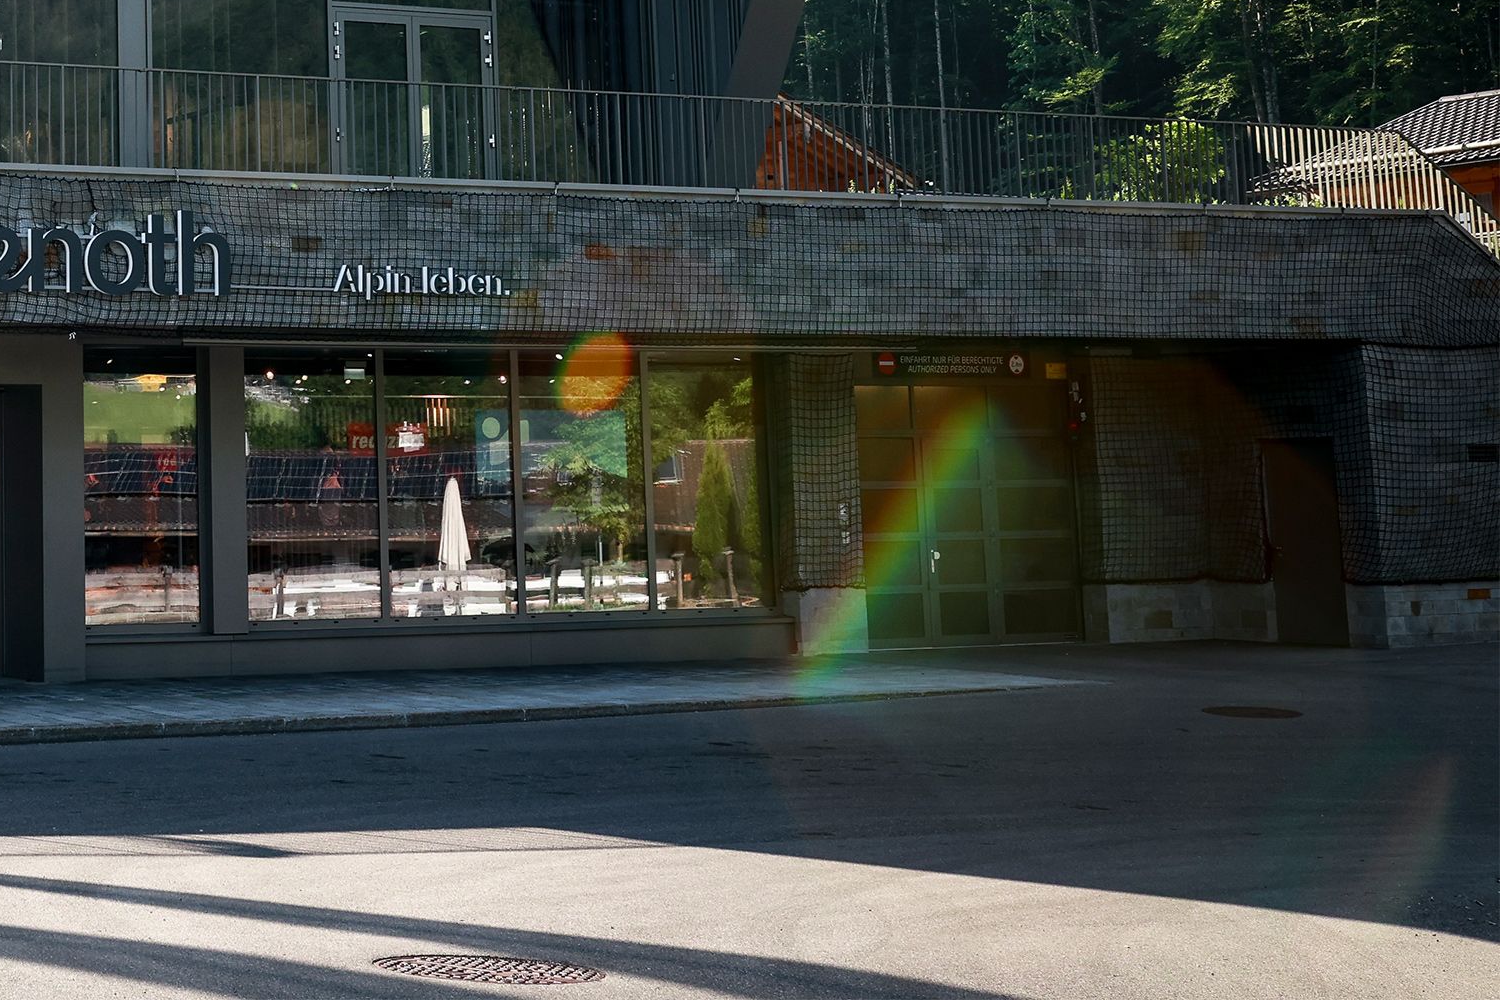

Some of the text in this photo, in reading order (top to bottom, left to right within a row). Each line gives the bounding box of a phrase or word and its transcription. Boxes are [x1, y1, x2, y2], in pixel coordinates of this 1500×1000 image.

[333, 264, 511, 301] Alpin leben.
[900, 355, 931, 364] EINFAHRT
[932, 356, 947, 364] NUR
[948, 354, 961, 365] FÜR
[961, 356, 1004, 365] BERECHTIGTE
[907, 365, 997, 374] AUTHORIZED PERSONS ONLY
